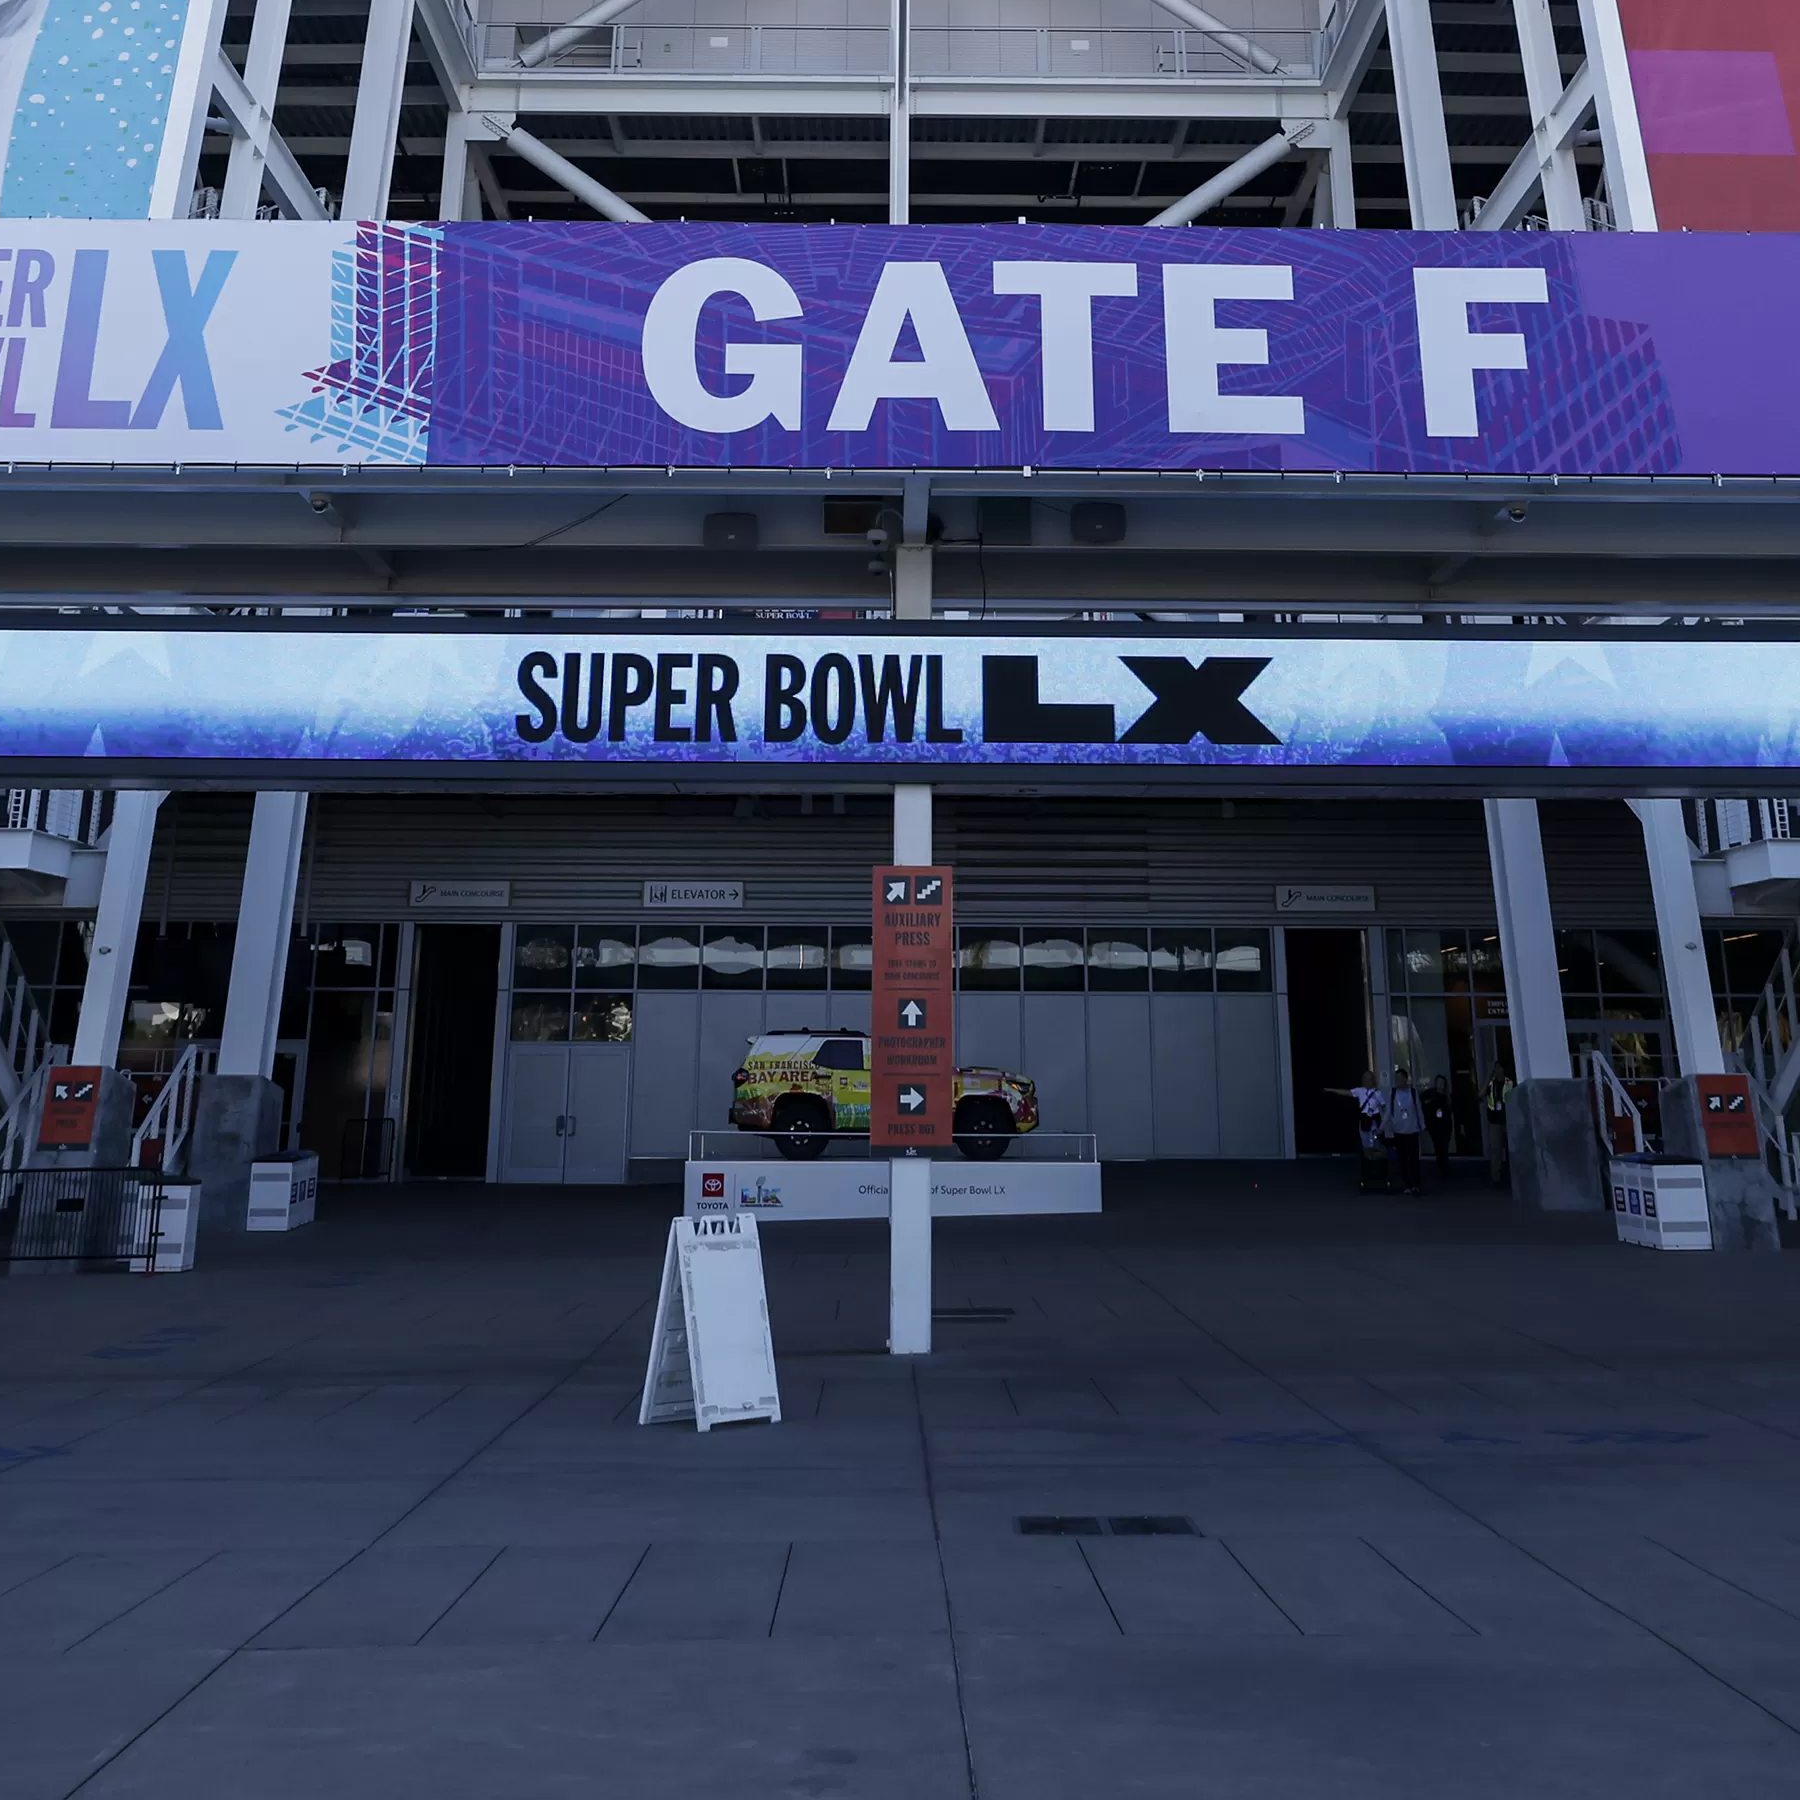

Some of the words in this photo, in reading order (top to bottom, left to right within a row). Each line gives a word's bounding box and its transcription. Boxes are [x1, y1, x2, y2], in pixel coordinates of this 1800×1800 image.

[50, 248, 239, 430] LX
[641, 256, 1306, 435] GATE
[1412, 267, 1550, 439] F
[516, 650, 740, 745] SUPER
[766, 651, 964, 746] BOWL
[980, 654, 1284, 746] LX
[670, 889, 726, 901] ELEVATOR
[883, 911, 942, 928] AUXILIARY
[894, 931, 931, 946] PRESS
[748, 1060, 765, 1071] SAN
[747, 1071, 777, 1085] BAY
[778, 1070, 819, 1083] AREA
[887, 1124, 916, 1135] PRESS
[858, 1185, 890, 1195] Officia
[940, 1185, 968, 1197] Super
[969, 1185, 993, 1195] Bowl
[994, 1185, 1006, 1195] LX
[696, 1202, 729, 1210] TOYOTA
